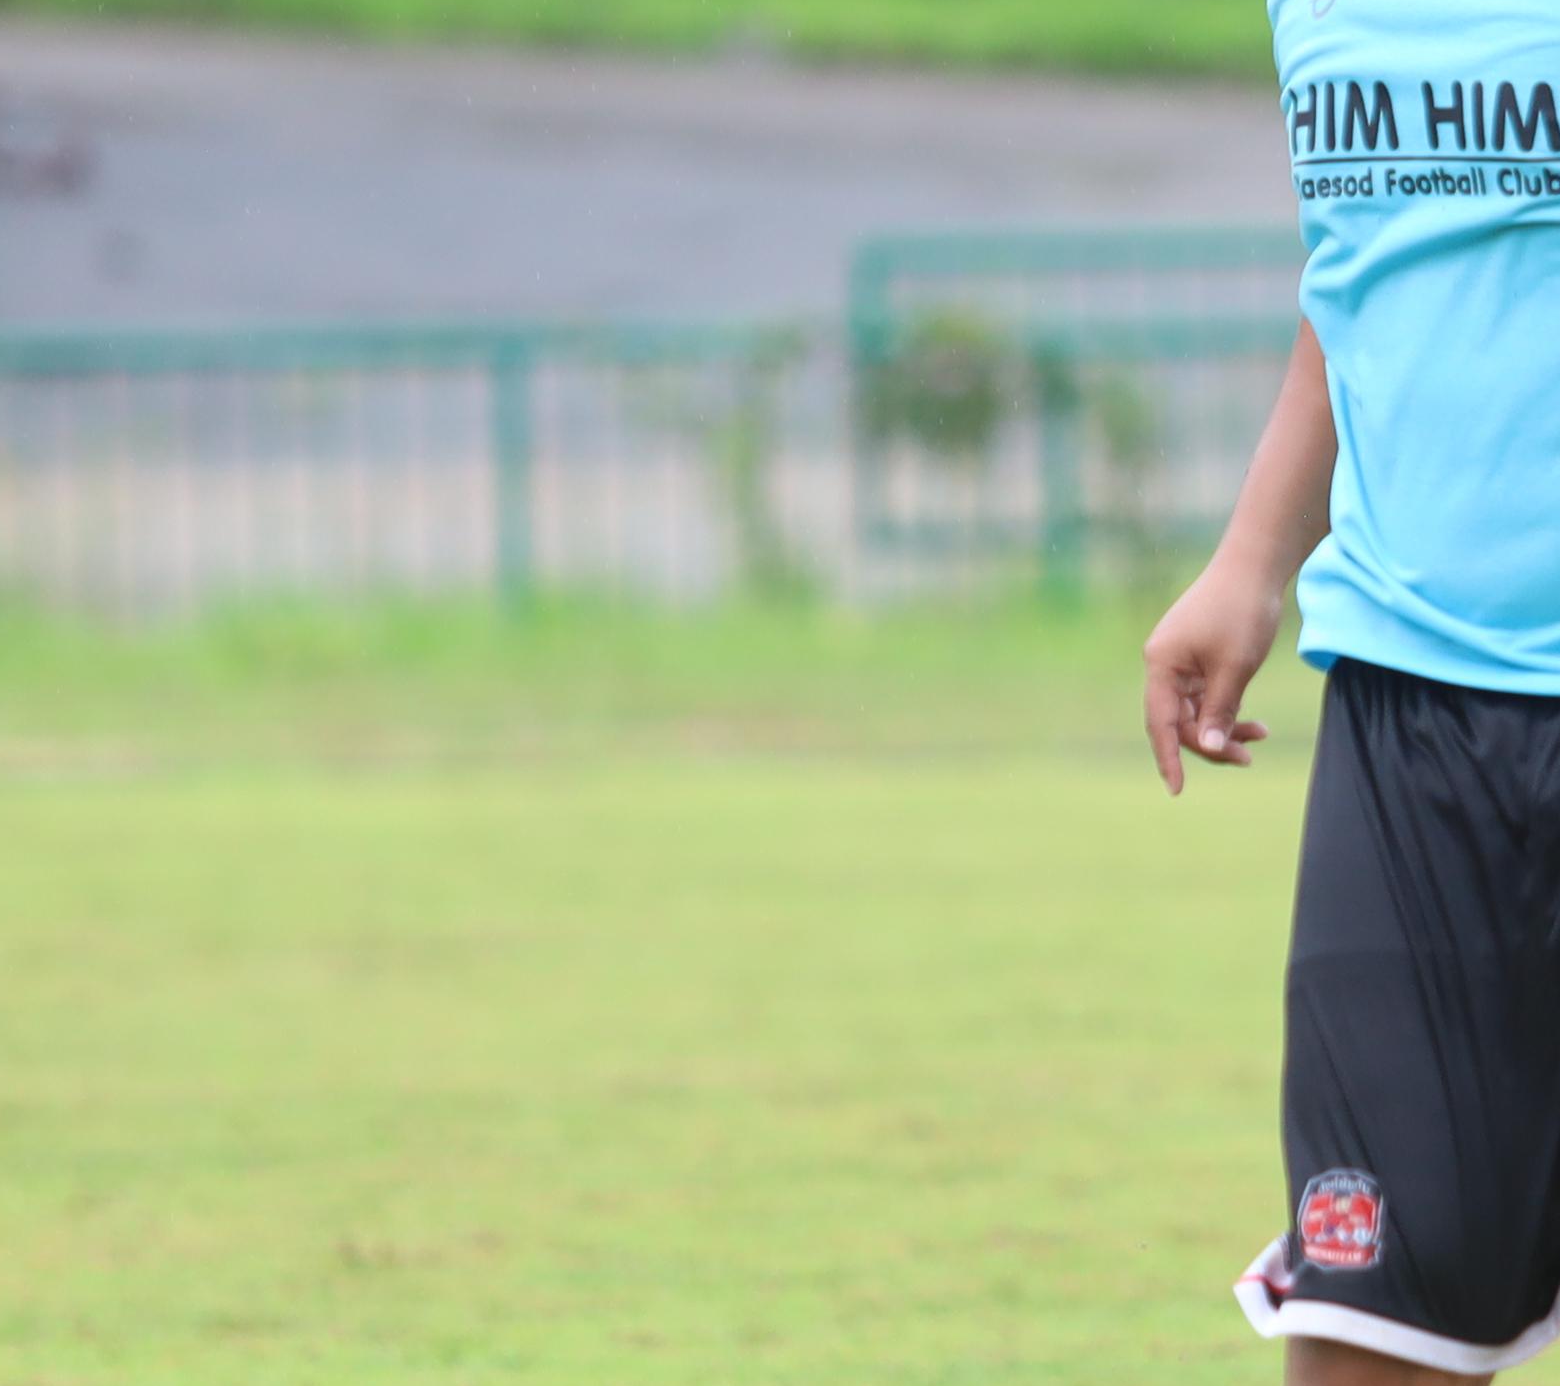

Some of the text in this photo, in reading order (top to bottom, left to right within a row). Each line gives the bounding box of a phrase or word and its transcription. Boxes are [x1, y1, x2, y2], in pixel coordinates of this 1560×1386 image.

[1288, 80, 1400, 156] HIM
[1295, 167, 1374, 201] aesod
[1384, 167, 1487, 197] Football
